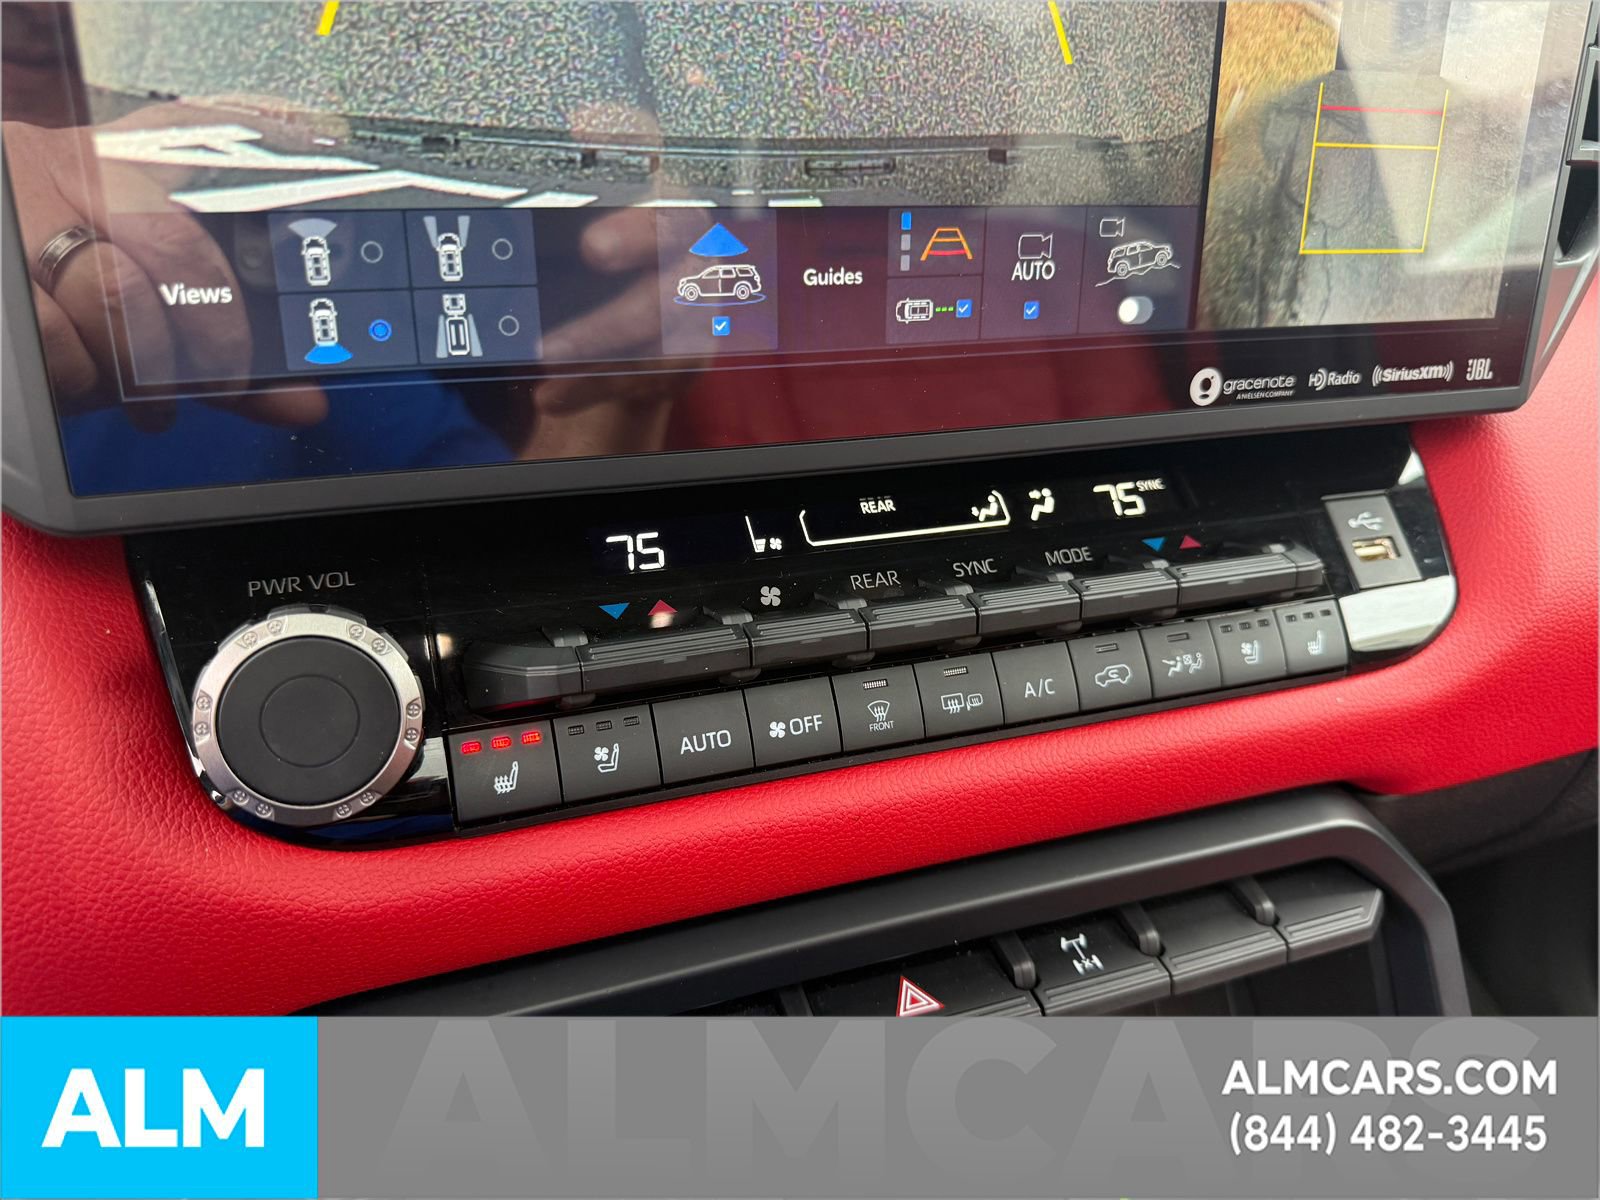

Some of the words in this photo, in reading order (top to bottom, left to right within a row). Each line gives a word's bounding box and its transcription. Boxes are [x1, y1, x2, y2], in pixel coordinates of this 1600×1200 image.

[802, 266, 864, 287] Guides
[1011, 260, 1056, 281] AUTO
[159, 282, 233, 306] Views
[1327, 372, 1362, 386] Radio
[1466, 358, 1493, 382] JBL
[1223, 375, 1297, 395] gracenote
[859, 498, 897, 515] REAR
[1093, 481, 1146, 516] 75
[1136, 478, 1165, 491] SYNC
[605, 531, 666, 571] 75
[1045, 547, 1093, 567] MODE
[952, 558, 997, 578] SYNC
[248, 576, 303, 597] PWR
[307, 571, 356, 591] VOL
[850, 570, 901, 590] REAR
[1023, 678, 1055, 699] A/C
[789, 714, 824, 736] OFF
[868, 720, 894, 733] FRONT
[679, 729, 732, 755] AUTO
